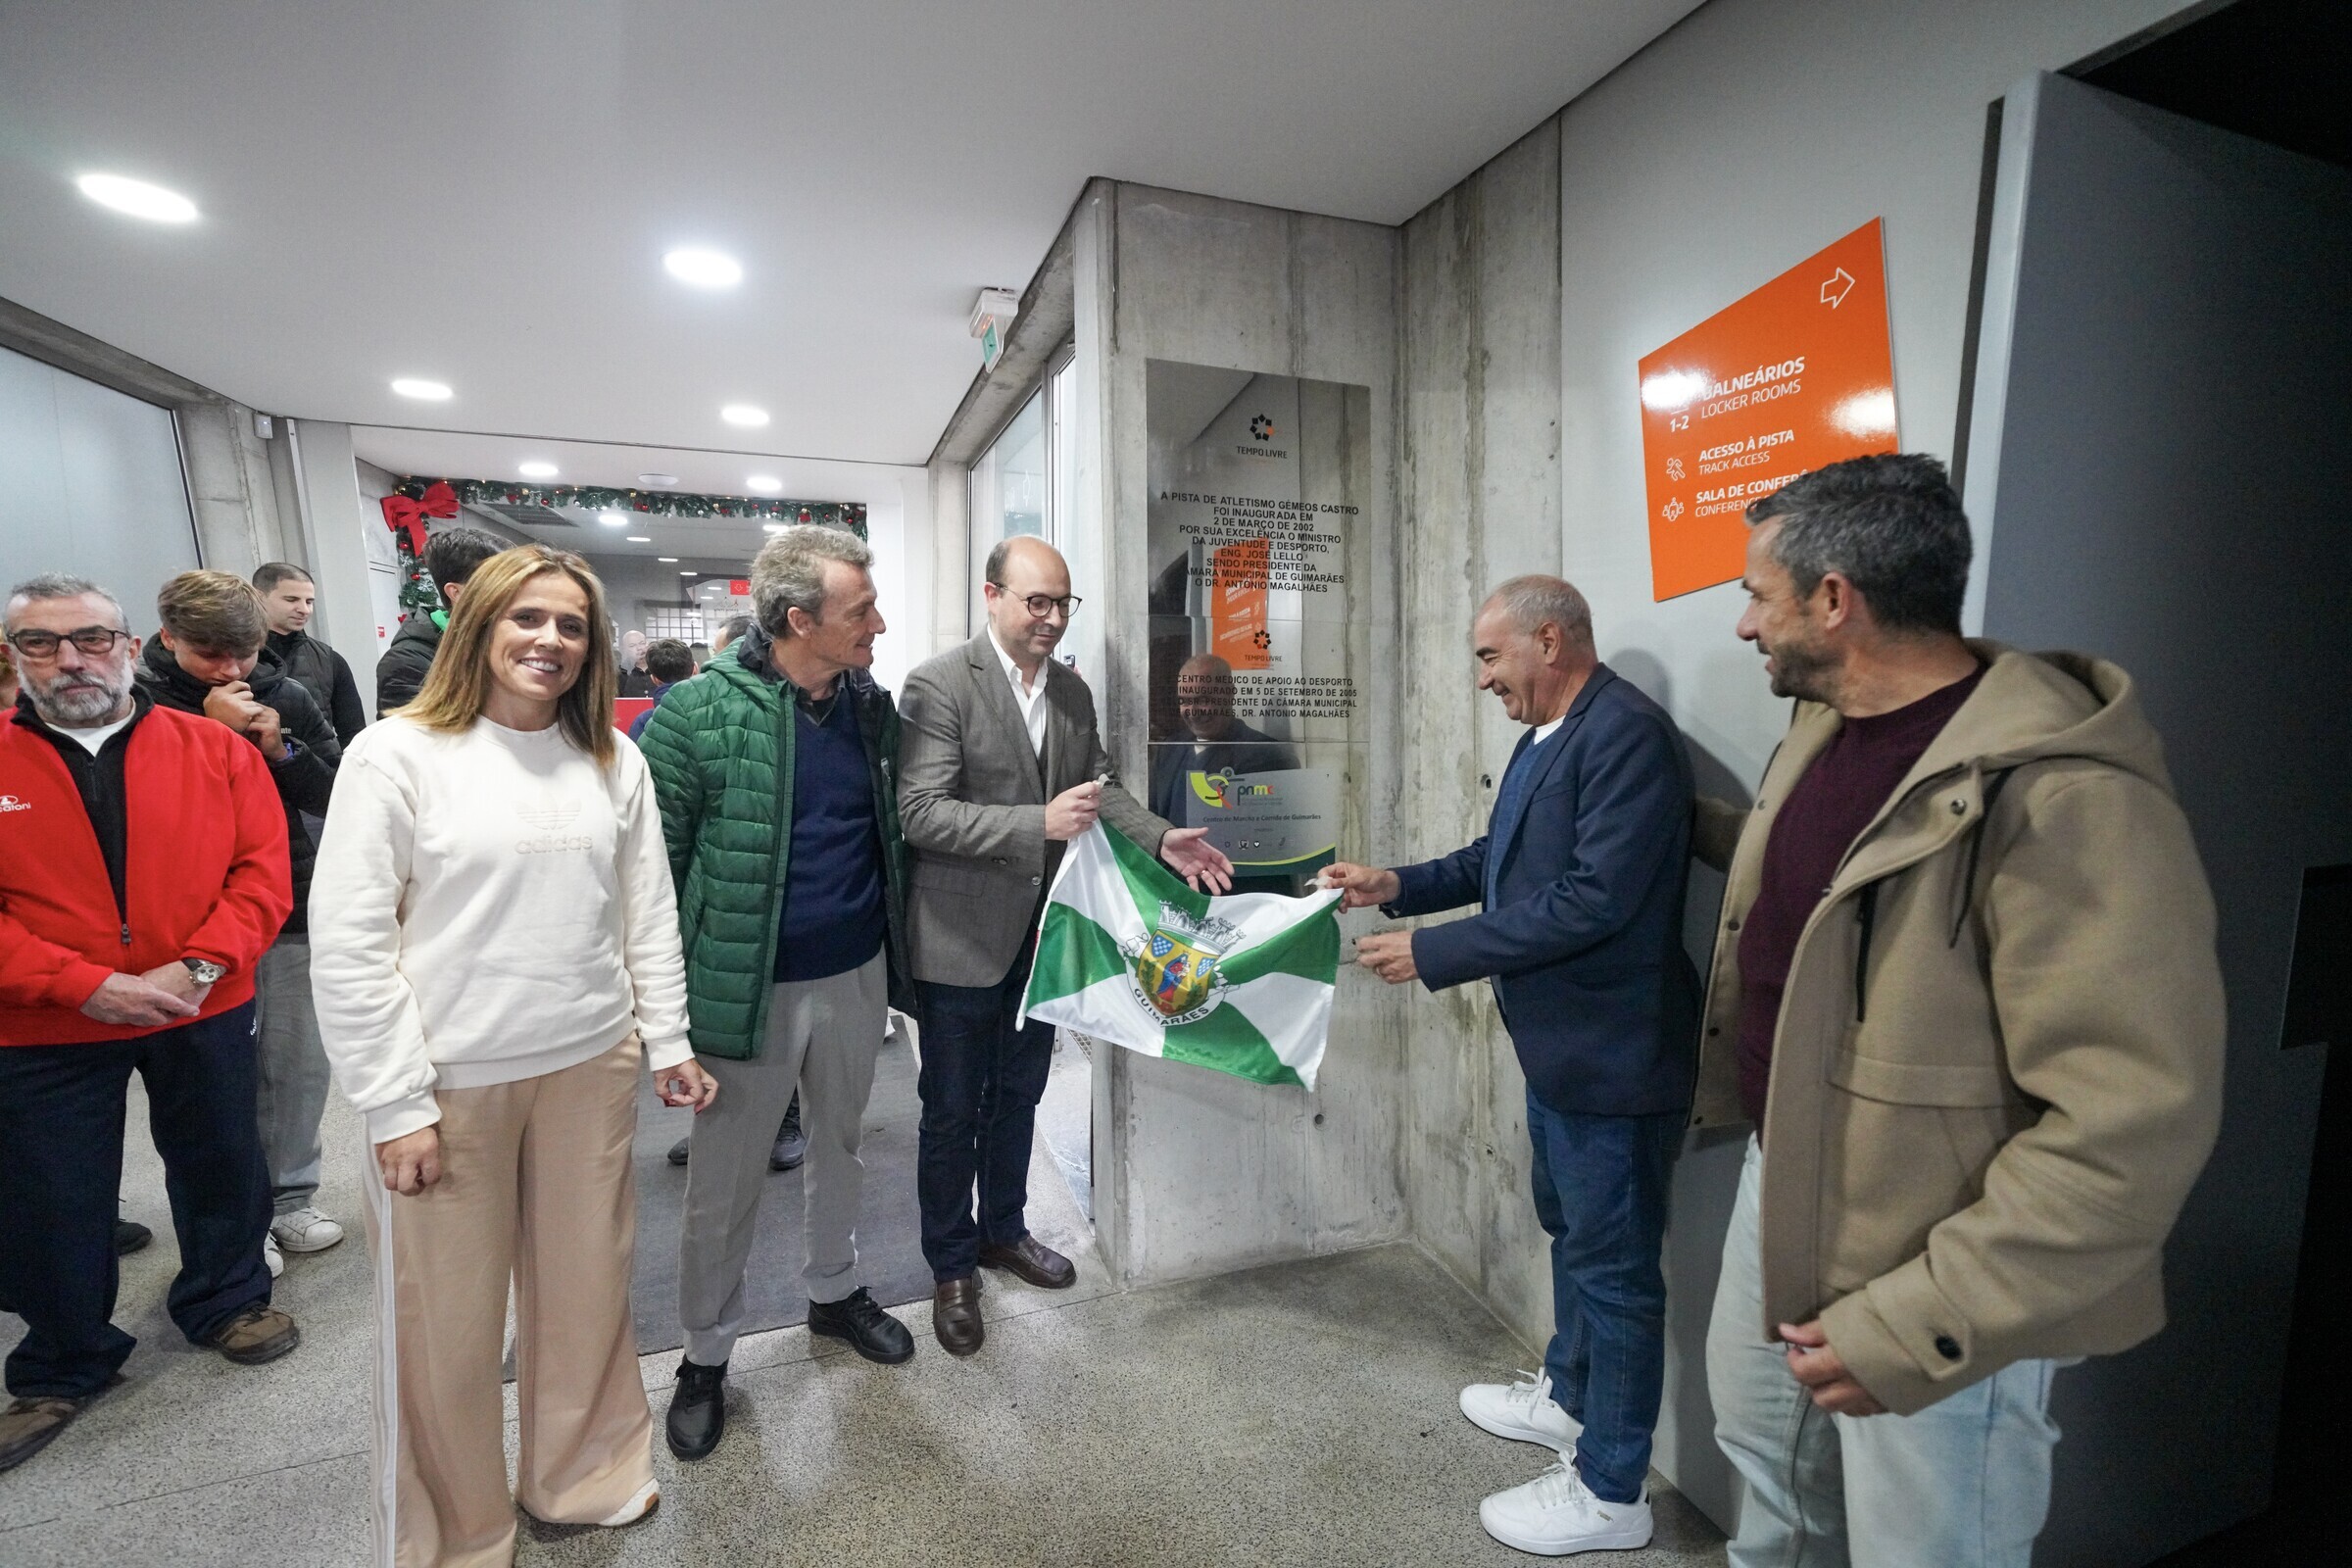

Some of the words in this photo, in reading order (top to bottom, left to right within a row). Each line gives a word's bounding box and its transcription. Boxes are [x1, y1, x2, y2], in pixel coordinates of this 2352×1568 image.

[1703, 356, 1805, 401] BALNEÁRIOS
[1701, 393, 1748, 418] LOCKER
[1751, 378, 1801, 405] ROOMS
[1670, 415, 1690, 433] 1-2
[1237, 446, 1264, 457] TEMPO
[1266, 449, 1288, 459] LIVRE
[1698, 441, 1744, 462] ACESSO
[1758, 429, 1794, 449] PISTA
[1698, 459, 1731, 475] TRACK
[1732, 451, 1770, 468] ACCESS
[1696, 487, 1726, 504] SALA
[1728, 483, 1745, 498] DE
[1747, 468, 1808, 494] CONFER
[1160, 491, 1168, 501] A
[1171, 492, 1200, 503] PISTA
[1203, 495, 1217, 505] DE
[1220, 496, 1275, 509] ATLETISMO
[1321, 504, 1359, 515] CASTRO
[1213, 507, 1230, 515] FOI
[1232, 509, 1297, 520] INAUGURADA
[1299, 513, 1313, 521] EM
[1213, 516, 1219, 525] 2
[1222, 517, 1235, 526] DE
[1238, 519, 1274, 530] MARÇO
[1277, 521, 1291, 530] DE
[1294, 522, 1314, 532] 2002
[1179, 524, 1200, 534] POR
[1202, 526, 1224, 536] SUA
[1226, 527, 1286, 540] EXCELÊNCIA
[1298, 532, 1342, 544] MINISTRO
[1192, 536, 1205, 545] DA
[1208, 537, 1265, 549] JUVENTUDE
[1268, 541, 1275, 550] E
[1277, 541, 1330, 554] DESPORTO,
[1273, 551, 1303, 562] LELLO
[1206, 558, 1241, 567] SENDO
[1243, 560, 1301, 571] PRESIDENTE
[1303, 563, 1317, 572] DA
[1221, 568, 1273, 580] MUNICIPAL
[1275, 571, 1288, 580] DE
[1290, 572, 1345, 584] GUIMARÃES
[1195, 577, 1202, 587] O
[1270, 582, 1328, 593] MAGALHÃES
[1176, 674, 1212, 684] CENTRO
[1295, 677, 1306, 686] AO
[1179, 686, 1238, 695] INAUGURADO
[1278, 688, 1323, 697] SETEMBRO
[1205, 698, 1259, 707] PRESIDENTE
[1262, 698, 1275, 707] DA
[1276, 697, 1311, 707] CÂMARA
[1314, 699, 1357, 708] MUNICIPAL
[1242, 709, 1256, 717] DR.
[514, 834, 593, 855] adidas
